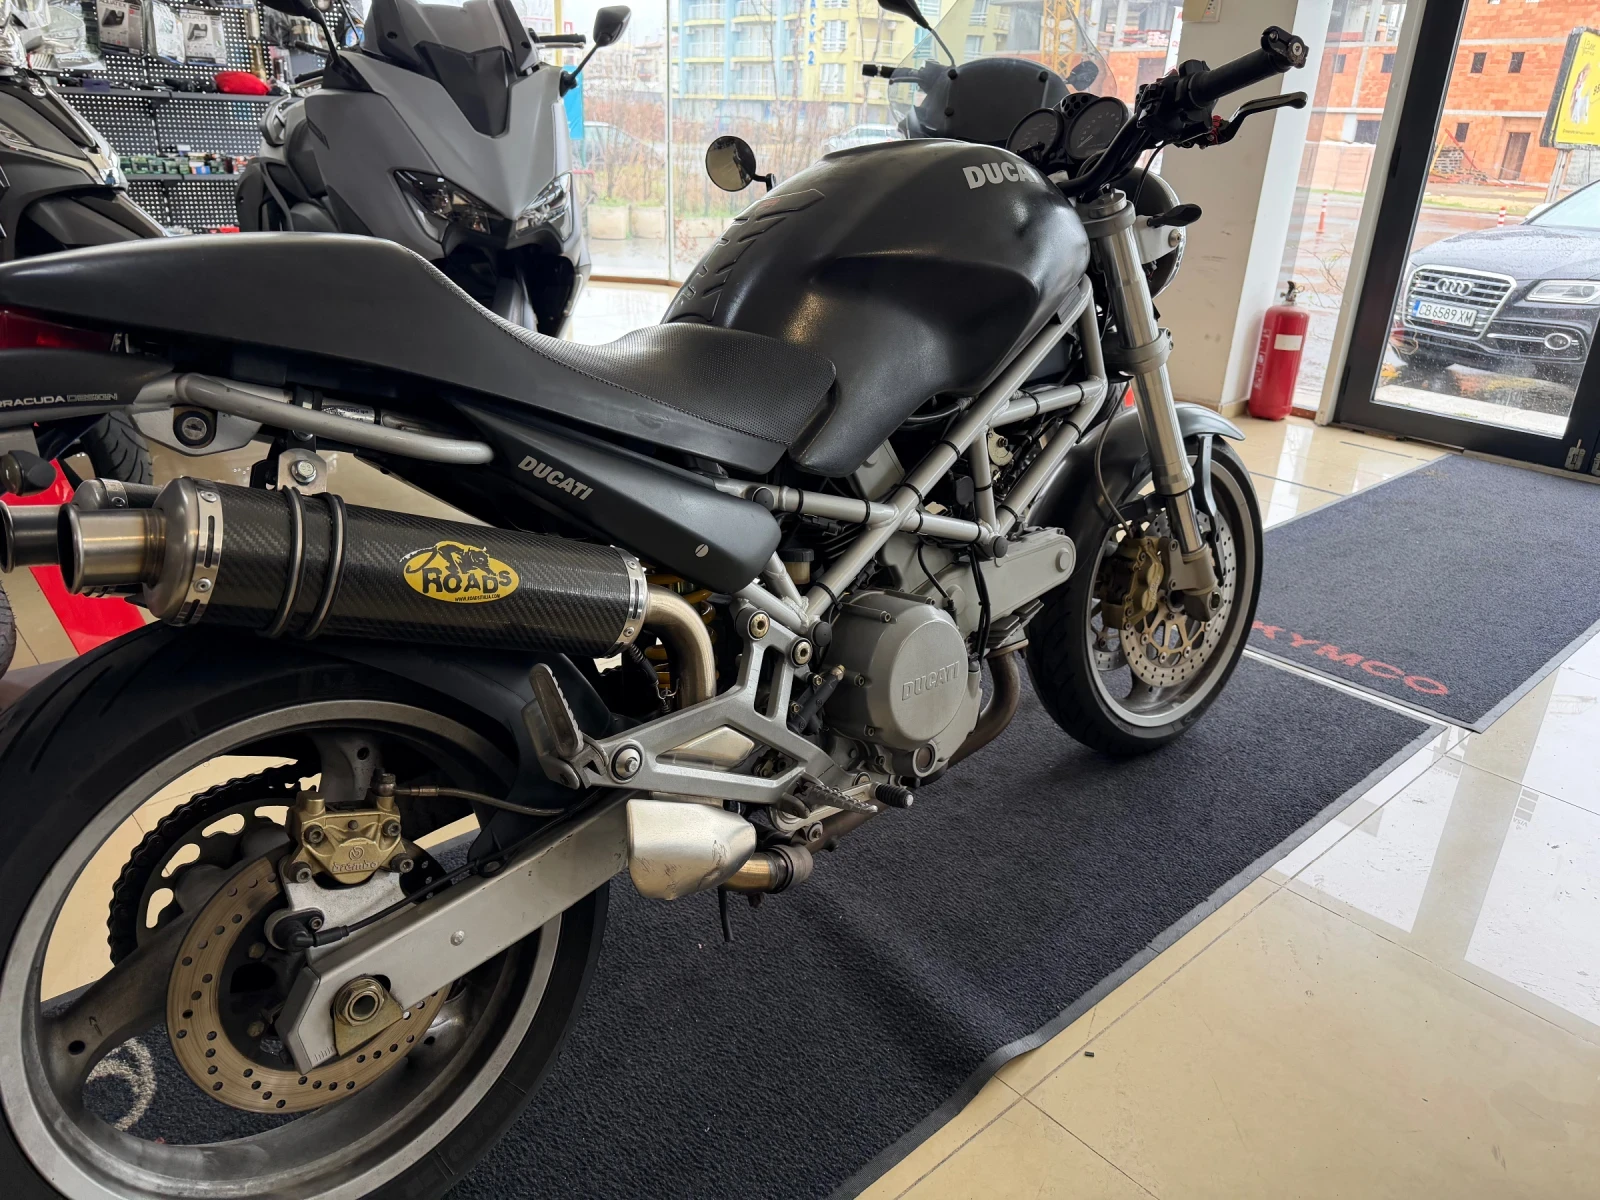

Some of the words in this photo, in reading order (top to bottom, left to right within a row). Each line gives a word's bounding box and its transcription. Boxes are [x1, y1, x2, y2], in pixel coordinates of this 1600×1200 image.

[808, 50, 815, 65] 2
[1432, 306, 1458, 321] 6589
[1457, 310, 1474, 324] XM
[0, 395, 66, 408] RACUDA
[67, 393, 118, 403] DESIGN
[517, 455, 594, 501] DUCATI
[422, 567, 512, 594] ROADS
[1251, 620, 1449, 696] KYMCO
[901, 660, 960, 701] DUCATI
[332, 860, 378, 872] brembo
